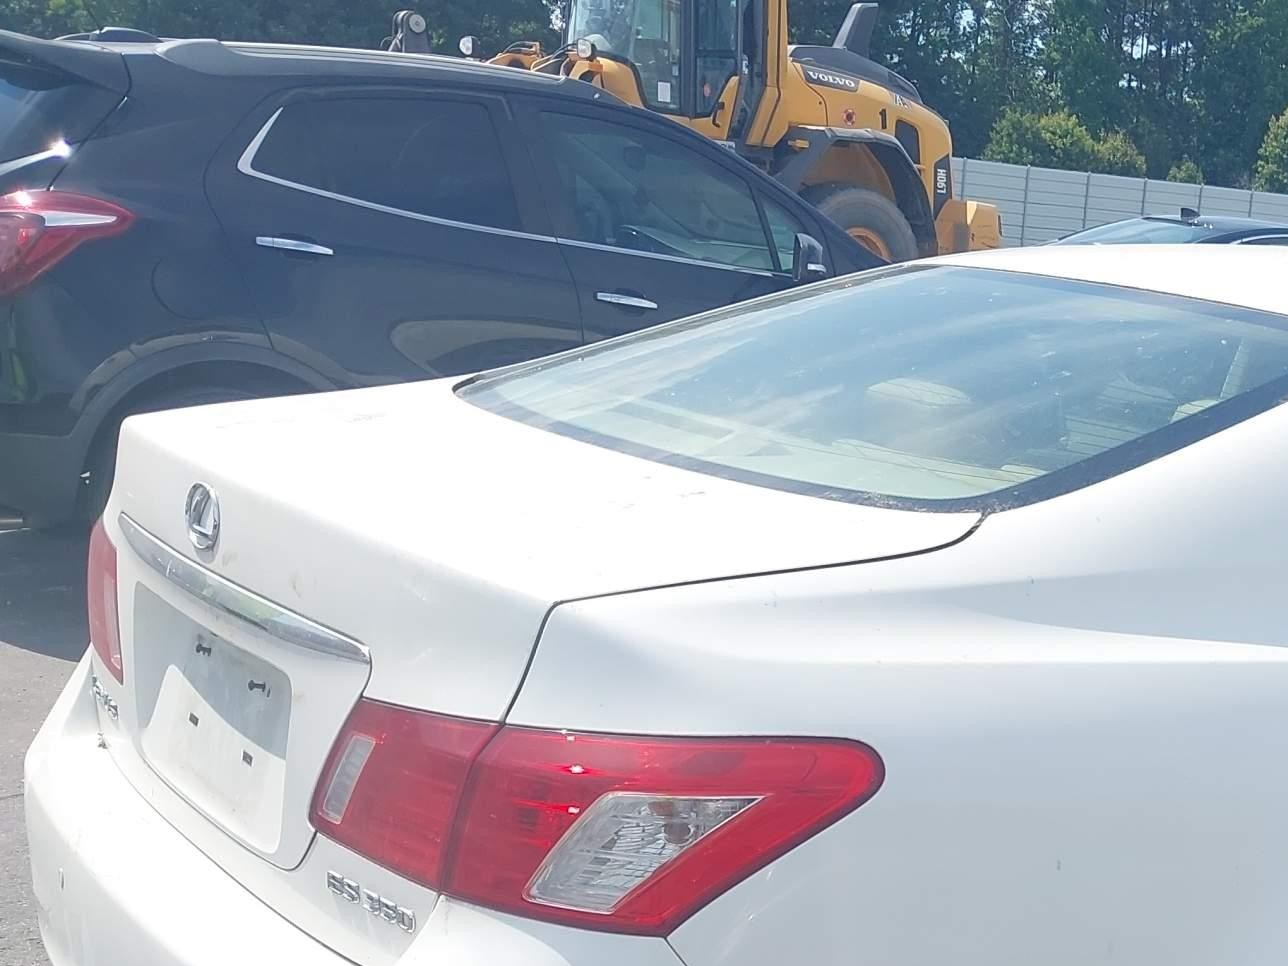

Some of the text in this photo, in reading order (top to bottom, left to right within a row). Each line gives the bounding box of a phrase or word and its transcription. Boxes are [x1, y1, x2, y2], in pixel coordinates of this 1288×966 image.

[807, 70, 855, 88] VOLVO
[879, 108, 887, 129] 1
[936, 168, 948, 194] L90H
[326, 870, 416, 934] ES 350
